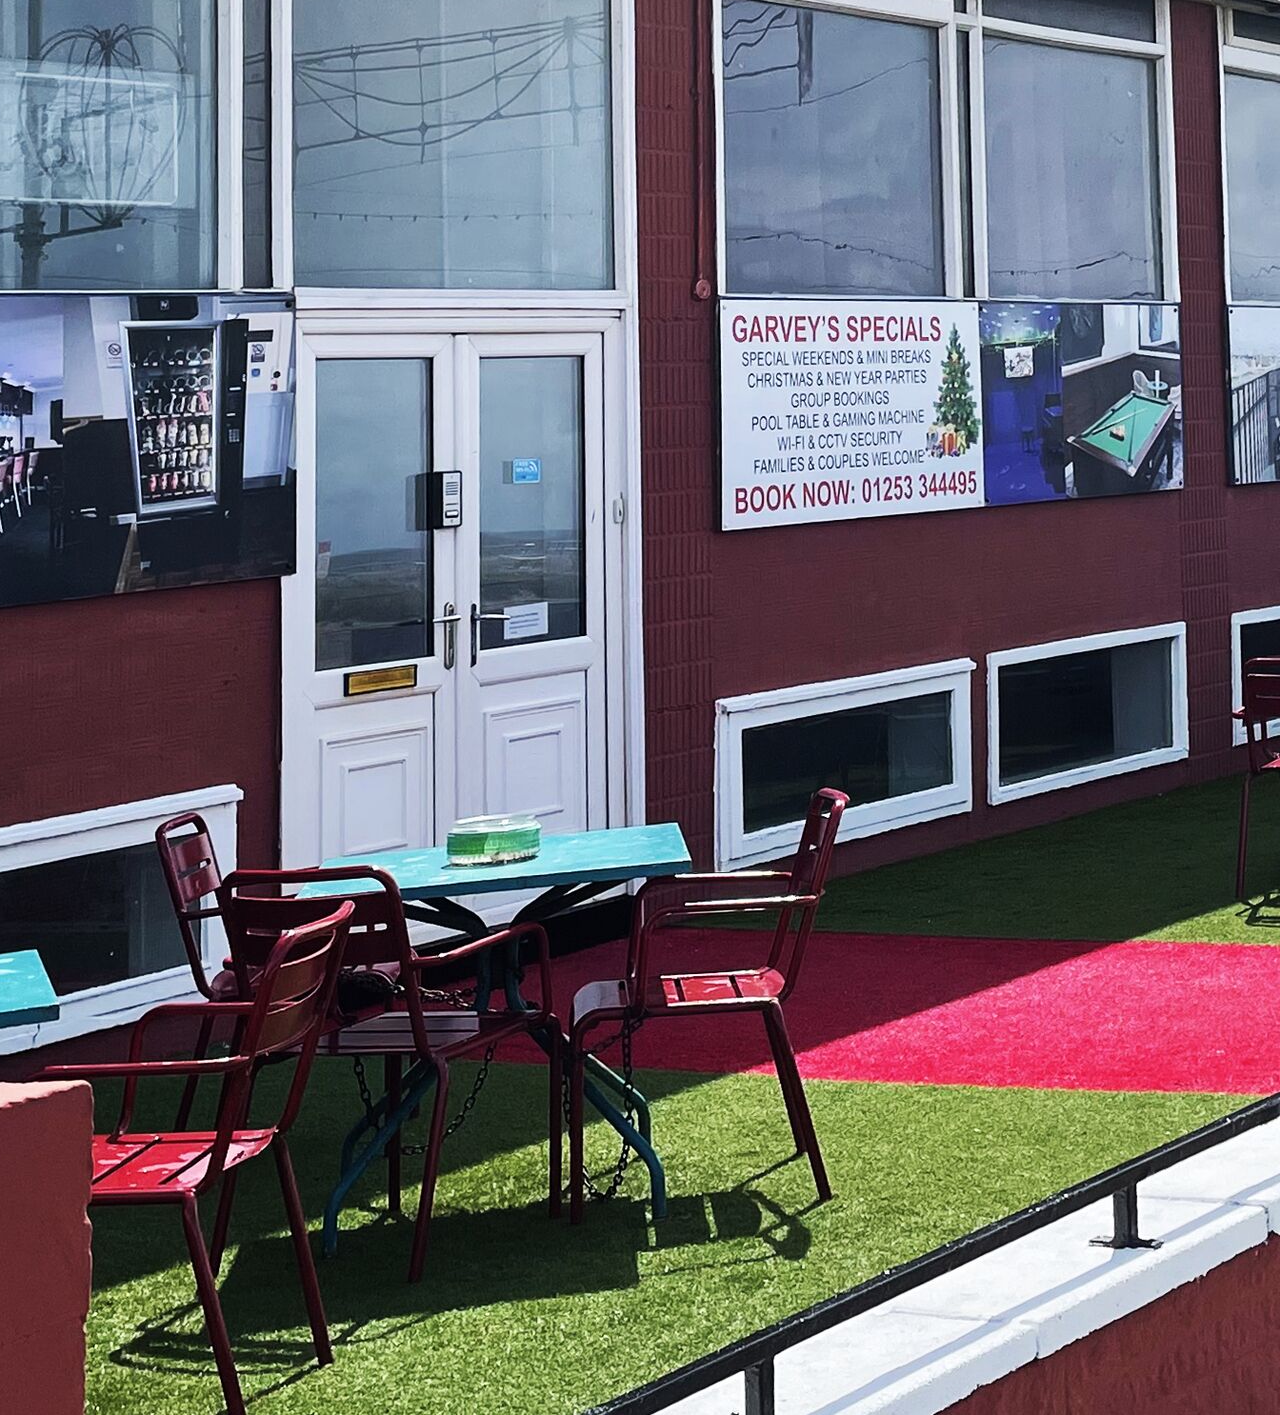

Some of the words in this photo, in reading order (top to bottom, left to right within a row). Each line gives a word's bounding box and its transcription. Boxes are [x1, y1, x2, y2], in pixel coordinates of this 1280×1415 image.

[732, 315, 840, 343] GARVEY'S
[846, 316, 941, 342] SPECIALS
[741, 351, 790, 367] SPECIAL
[792, 350, 854, 366] WEEKENDS
[857, 350, 864, 364] &
[866, 350, 888, 364] MINI
[891, 349, 931, 364] BREAKS
[747, 371, 814, 388] CHRISTMAS
[816, 371, 824, 386] &
[826, 370, 852, 386] NEW
[854, 370, 883, 385] YEAR
[885, 369, 927, 384] PARTIES
[791, 392, 831, 408] GROUP
[833, 390, 890, 407] BOOKINGS
[751, 416, 783, 431] POOL
[786, 413, 820, 429] TABLE
[823, 412, 830, 427] &
[833, 411, 876, 427] GAMING
[878, 409, 924, 426] MACHINE
[777, 436, 805, 451] WI-FI
[808, 434, 815, 449] &
[818, 433, 849, 449] CCTV
[849, 430, 903, 447] SECURITY
[754, 457, 805, 474] FAMILIES
[807, 455, 815, 471] &
[818, 453, 869, 470] COUPLES
[872, 450, 925, 466] WELCOME
[735, 484, 796, 514] BOOK
[803, 480, 856, 508] NOW:
[862, 475, 913, 503] 01253
[919, 470, 977, 498] 344495
